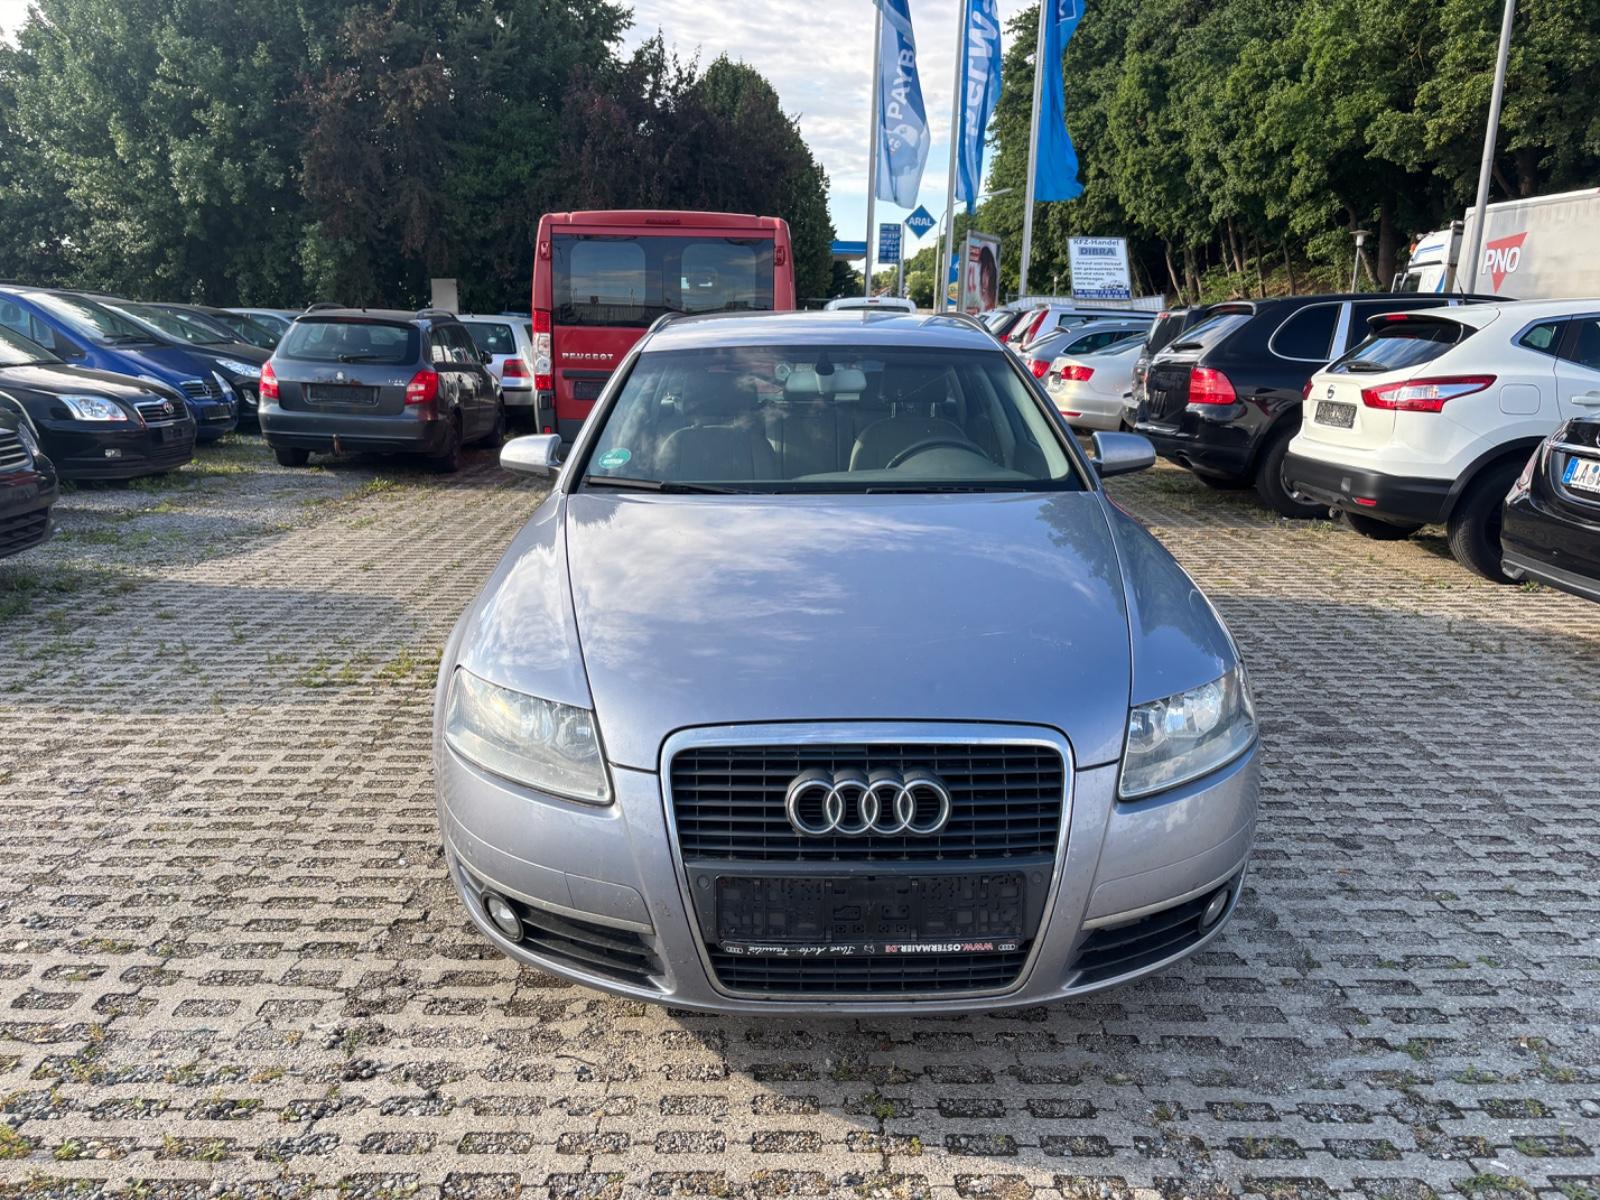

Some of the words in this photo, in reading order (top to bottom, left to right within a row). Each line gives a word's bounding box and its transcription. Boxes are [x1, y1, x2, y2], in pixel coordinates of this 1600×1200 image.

[908, 217, 932, 226] ARAL
[1080, 247, 1114, 256] DIBRA
[1481, 246, 1521, 274] PNO
[561, 352, 614, 360] PEUGEOT
